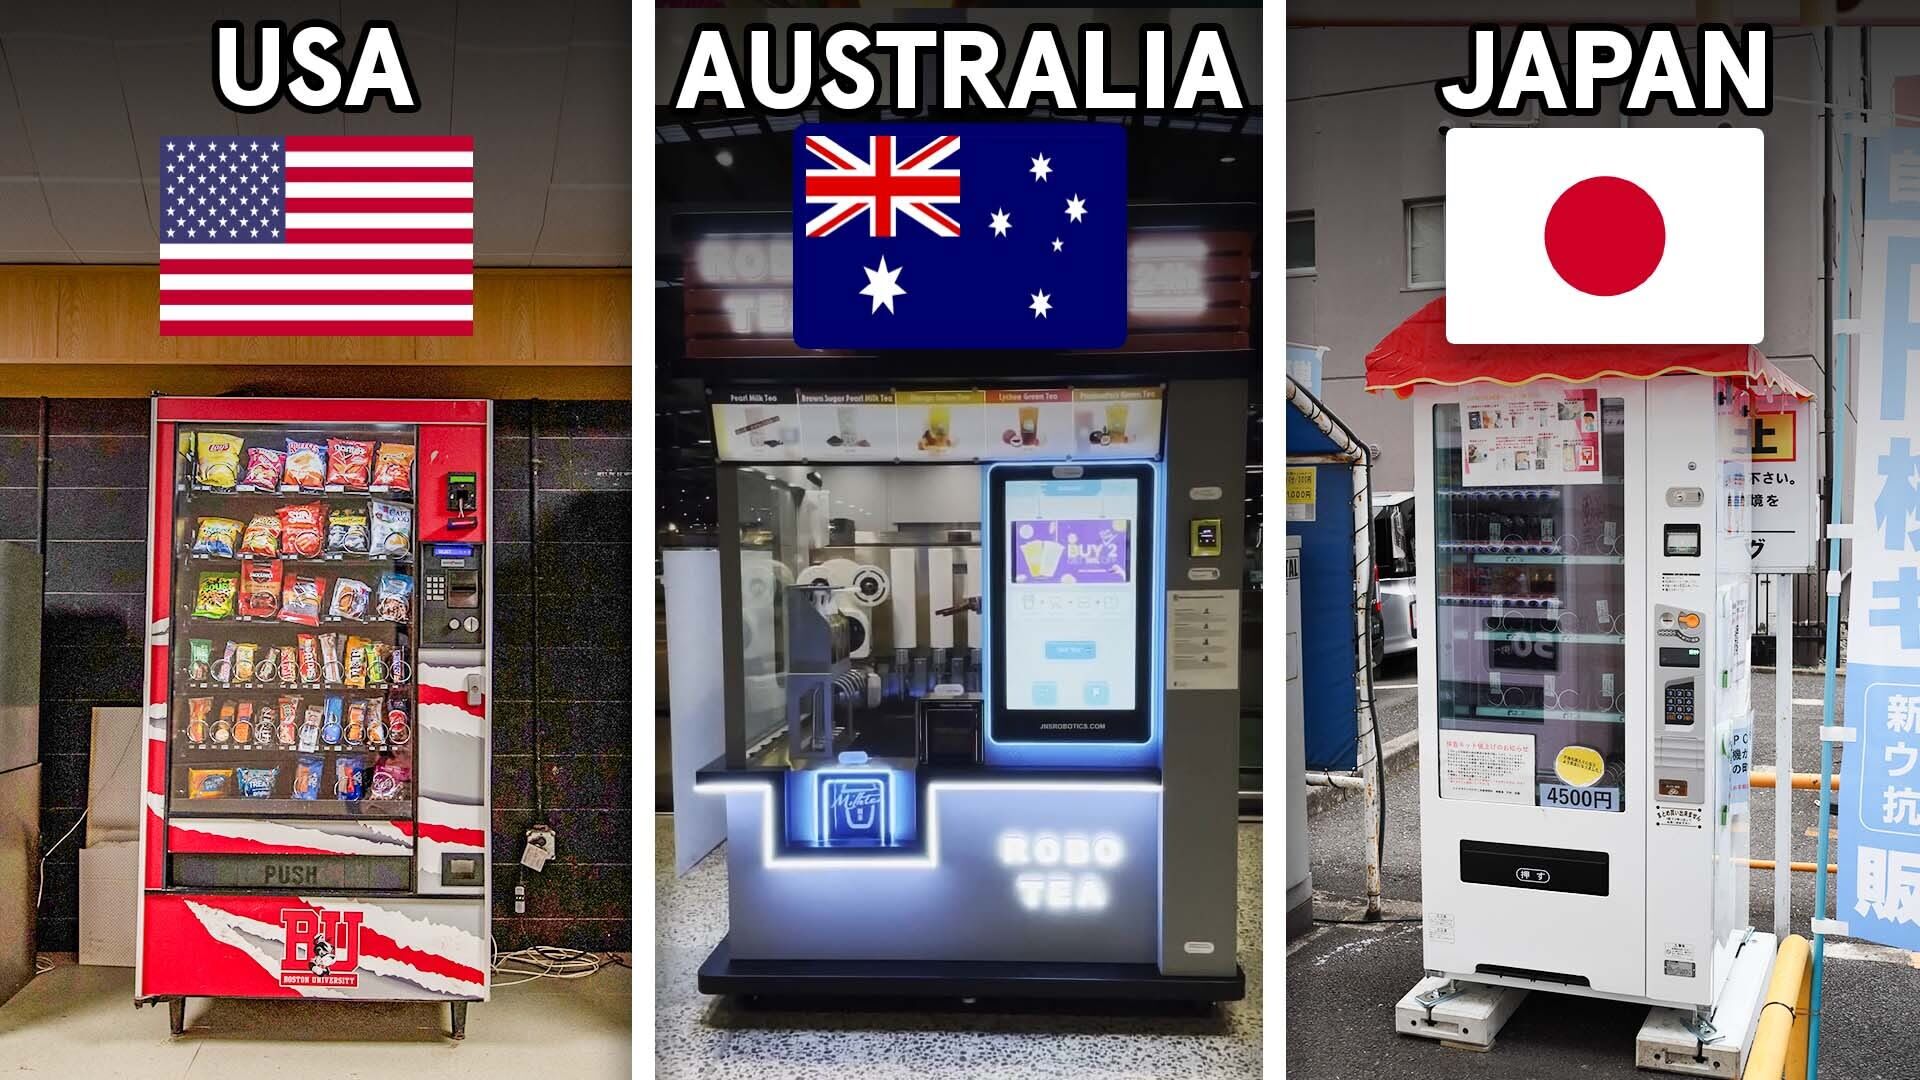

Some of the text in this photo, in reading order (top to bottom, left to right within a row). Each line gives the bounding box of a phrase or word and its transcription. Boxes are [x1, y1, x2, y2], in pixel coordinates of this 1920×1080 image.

[699, 240, 793, 283] ROB
[722, 294, 793, 335] TE
[730, 393, 777, 402] Pearl Milk Tea
[1023, 392, 1044, 400] Green
[1045, 392, 1058, 400] Tea
[1108, 543, 1118, 557] 2
[1286, 558, 1298, 577] AL
[1546, 787, 1612, 809] 4500円
[1000, 833, 1124, 866] ROBO
[264, 865, 318, 885] PUSH
[1520, 870, 1546, 881] 押す
[1016, 873, 1108, 911] TEA
[281, 909, 363, 972] BU
[283, 976, 355, 985] BOSTON UNIVERSITY
